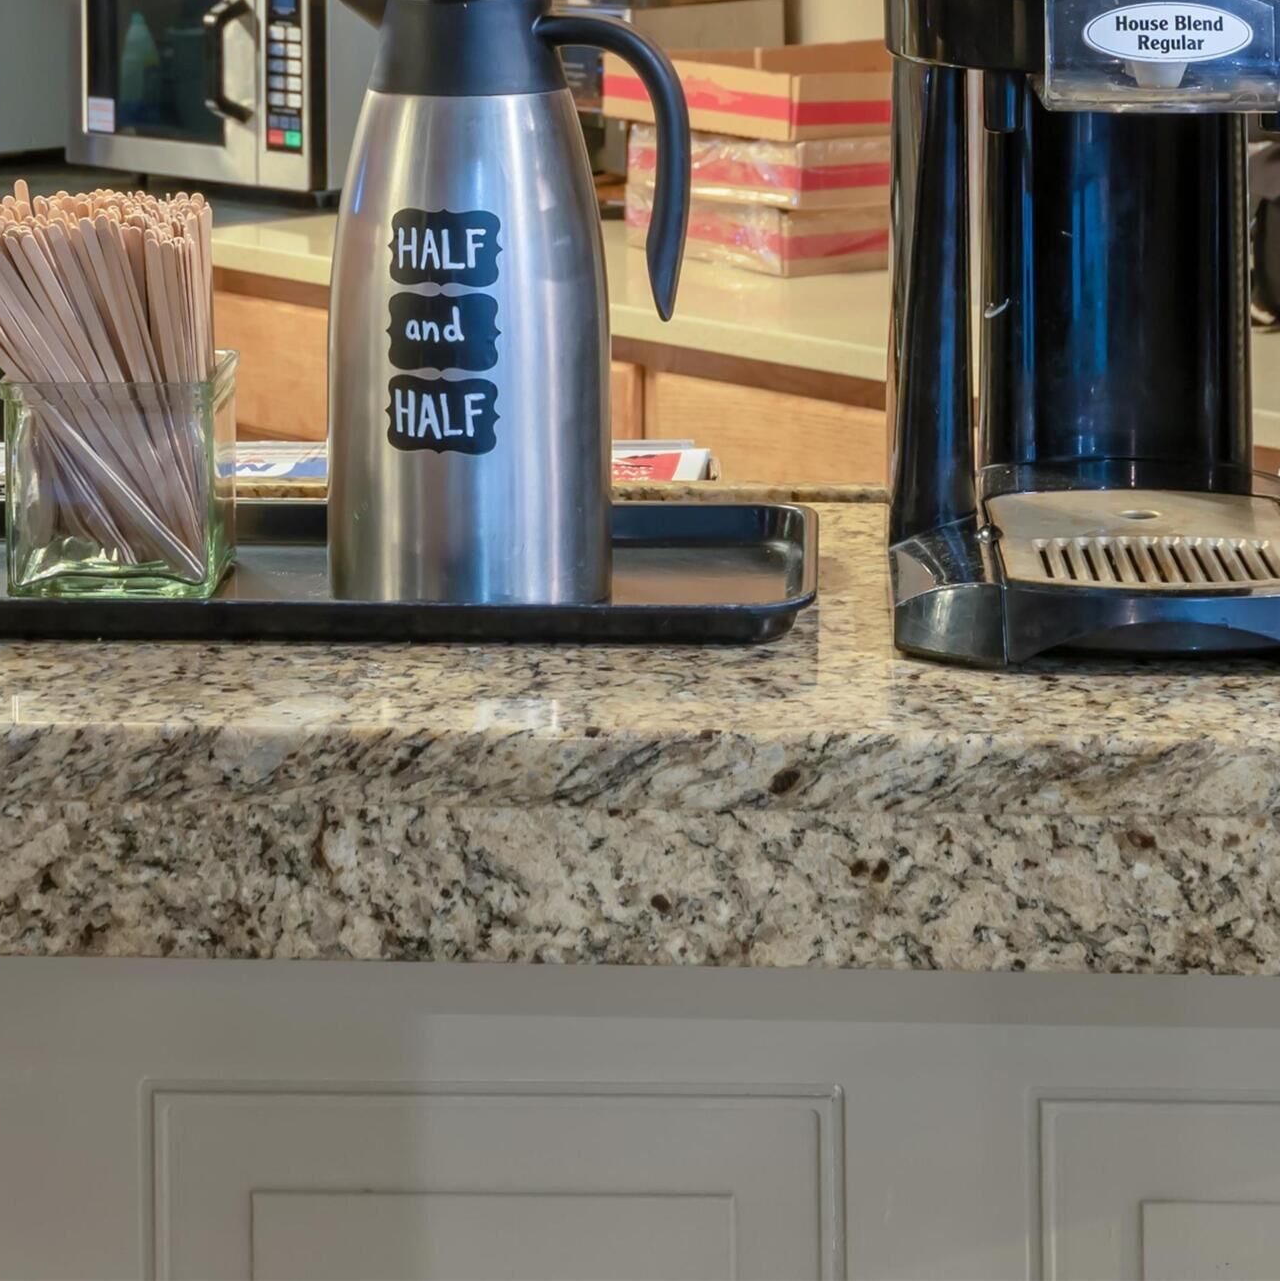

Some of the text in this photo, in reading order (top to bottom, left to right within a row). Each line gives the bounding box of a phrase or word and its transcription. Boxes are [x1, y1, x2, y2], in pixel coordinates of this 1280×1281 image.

[1115, 15, 1223, 32] House Blend
[1137, 34, 1205, 52] Regular
[396, 226, 487, 271] HALF
[405, 305, 465, 343] and
[394, 388, 486, 439] HALF
